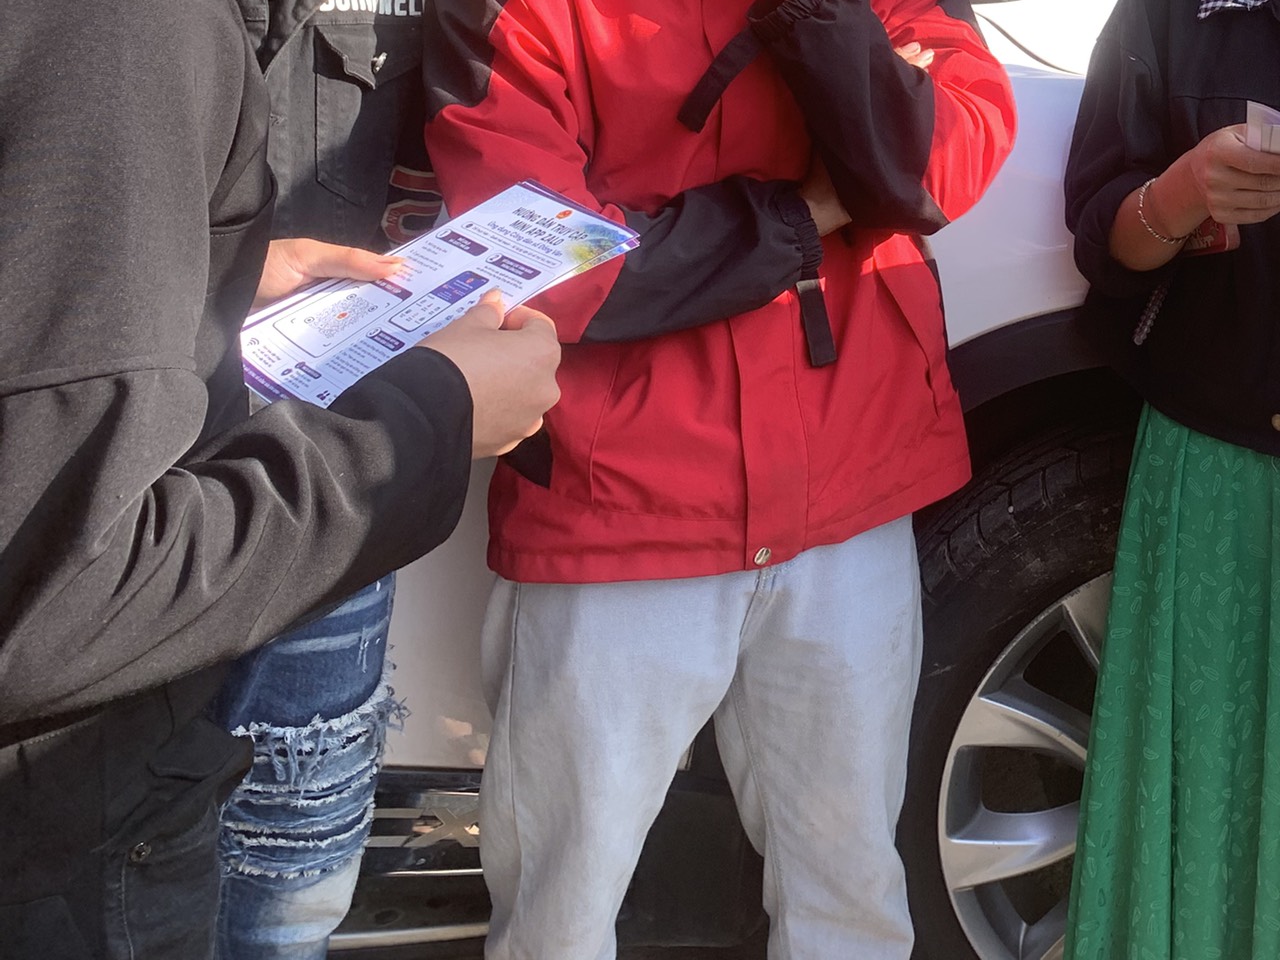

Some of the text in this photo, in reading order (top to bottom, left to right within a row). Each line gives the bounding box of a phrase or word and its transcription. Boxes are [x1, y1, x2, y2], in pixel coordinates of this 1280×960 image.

[509, 219, 565, 246] MINI APP ZALO
